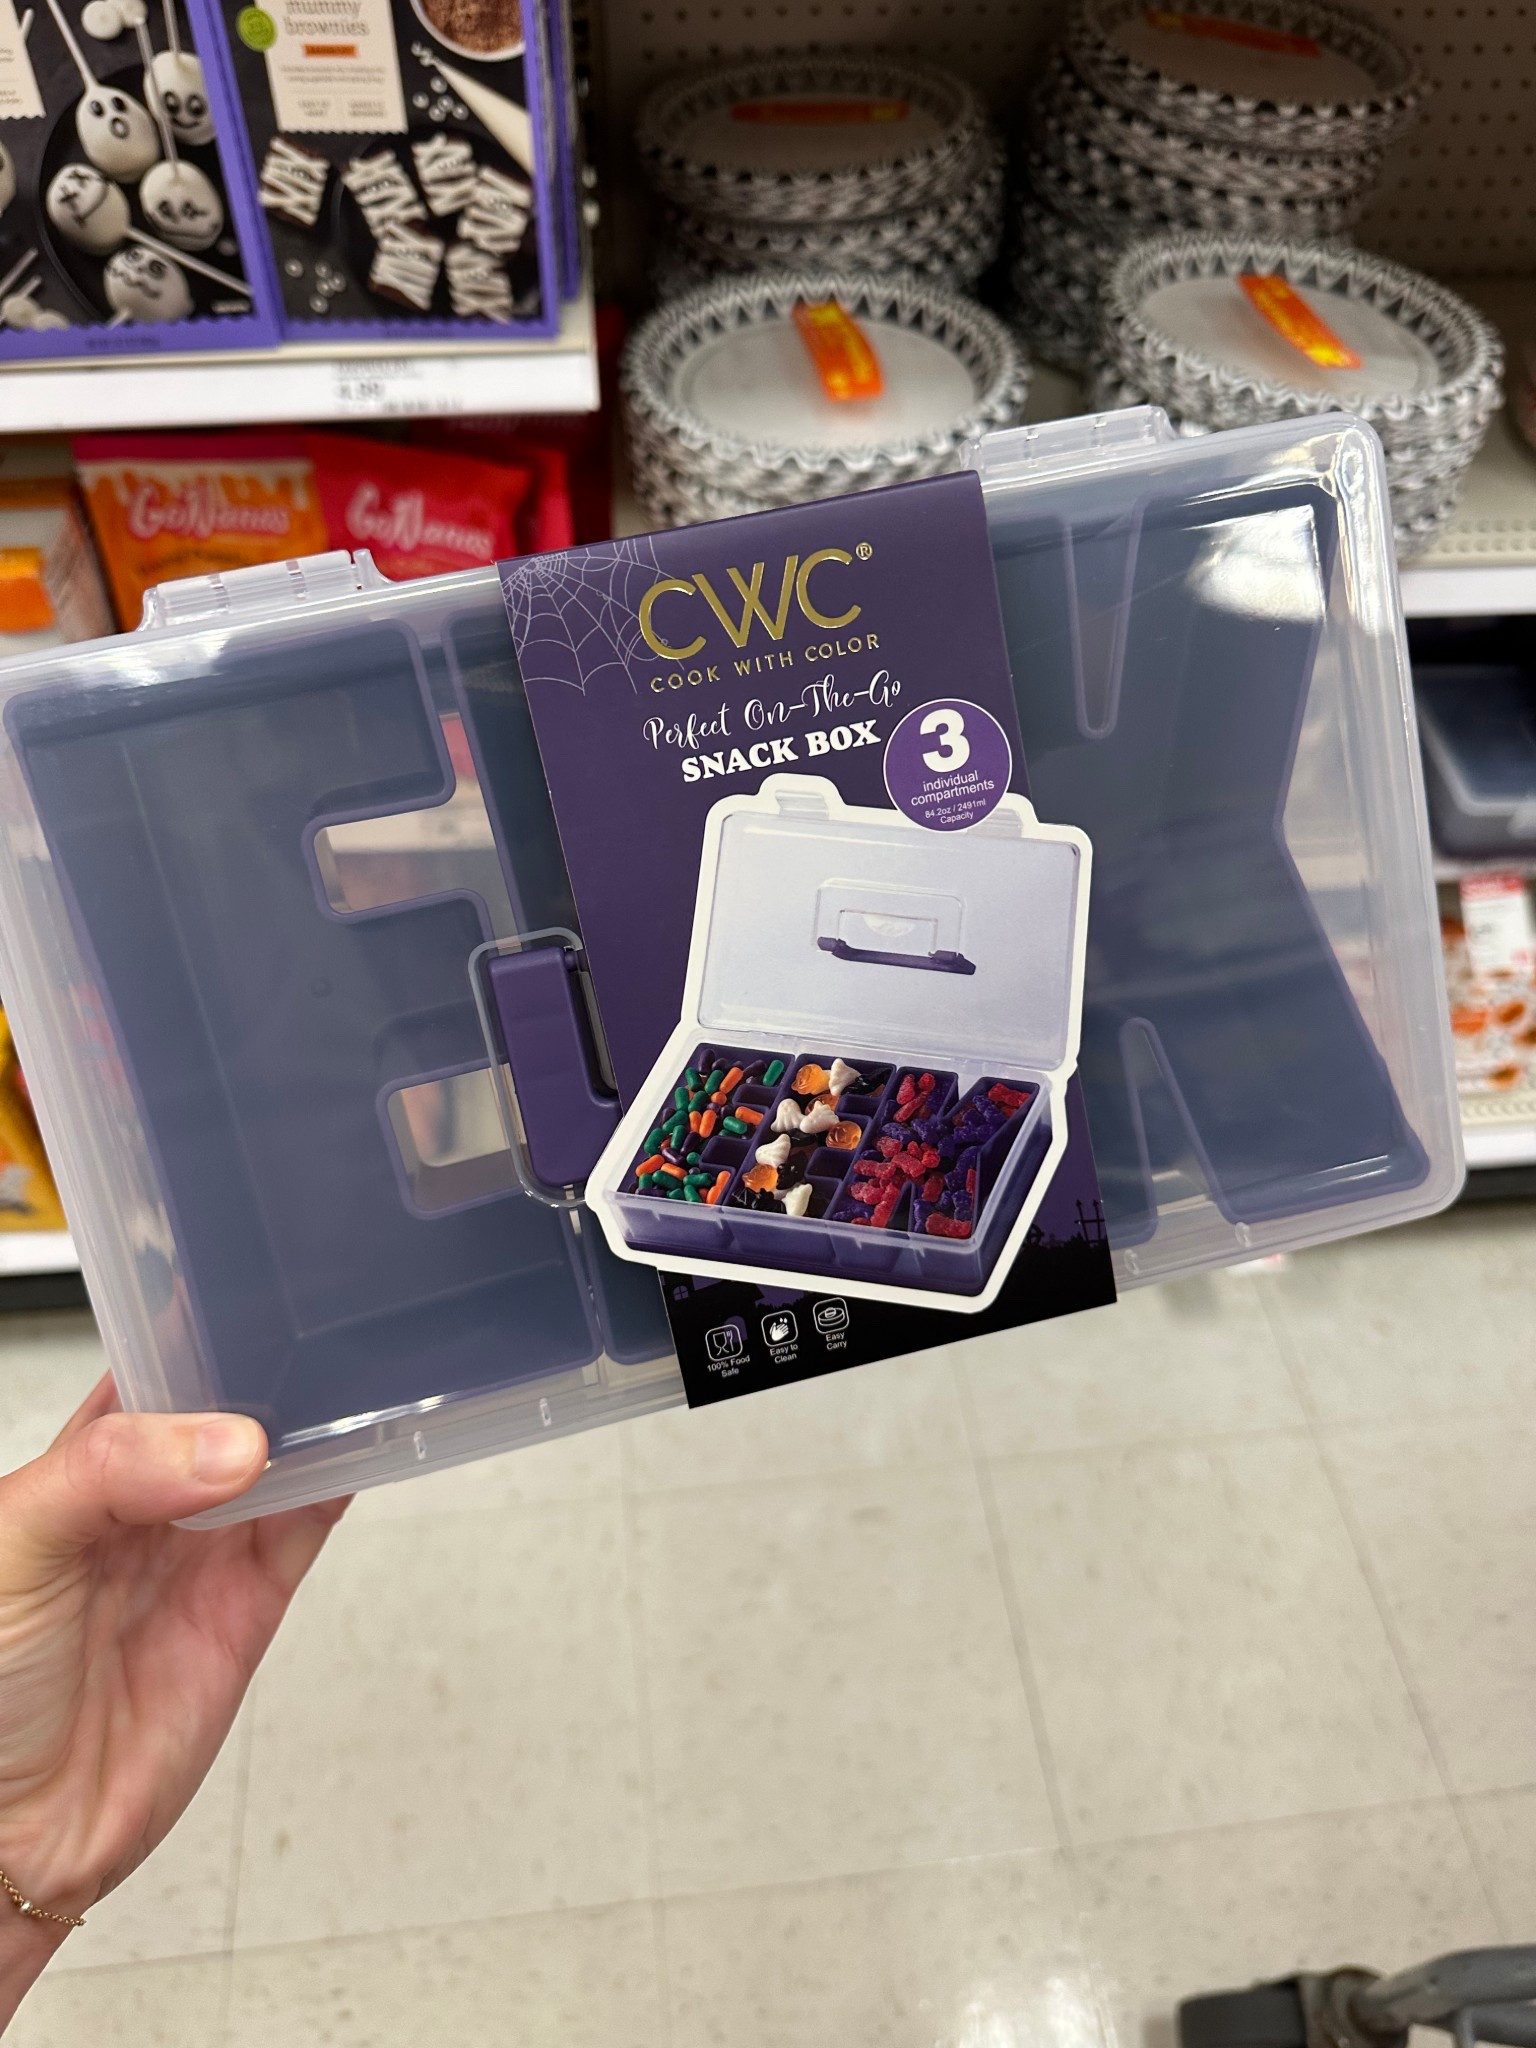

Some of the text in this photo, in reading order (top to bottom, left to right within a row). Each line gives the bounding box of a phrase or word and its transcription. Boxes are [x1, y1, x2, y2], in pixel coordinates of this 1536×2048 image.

[284, 17, 370, 36] brownies
[650, 633, 880, 693] COOK WITH COLOR
[643, 670, 901, 749] Perfect On-The-Go
[920, 708, 970, 773] 3
[682, 719, 881, 783] SNACK BOX
[922, 770, 979, 792] individual
[911, 780, 995, 806] compartments
[957, 798, 986, 811] 2491ml
[940, 811, 974, 824] Capacity
[826, 1332, 845, 1342] Easy
[826, 1340, 847, 1351] Carry
[769, 1343, 799, 1356] Easy to
[707, 1355, 750, 1372] 100% Food
[774, 1353, 797, 1364] Clean
[721, 1368, 740, 1378] Safe
